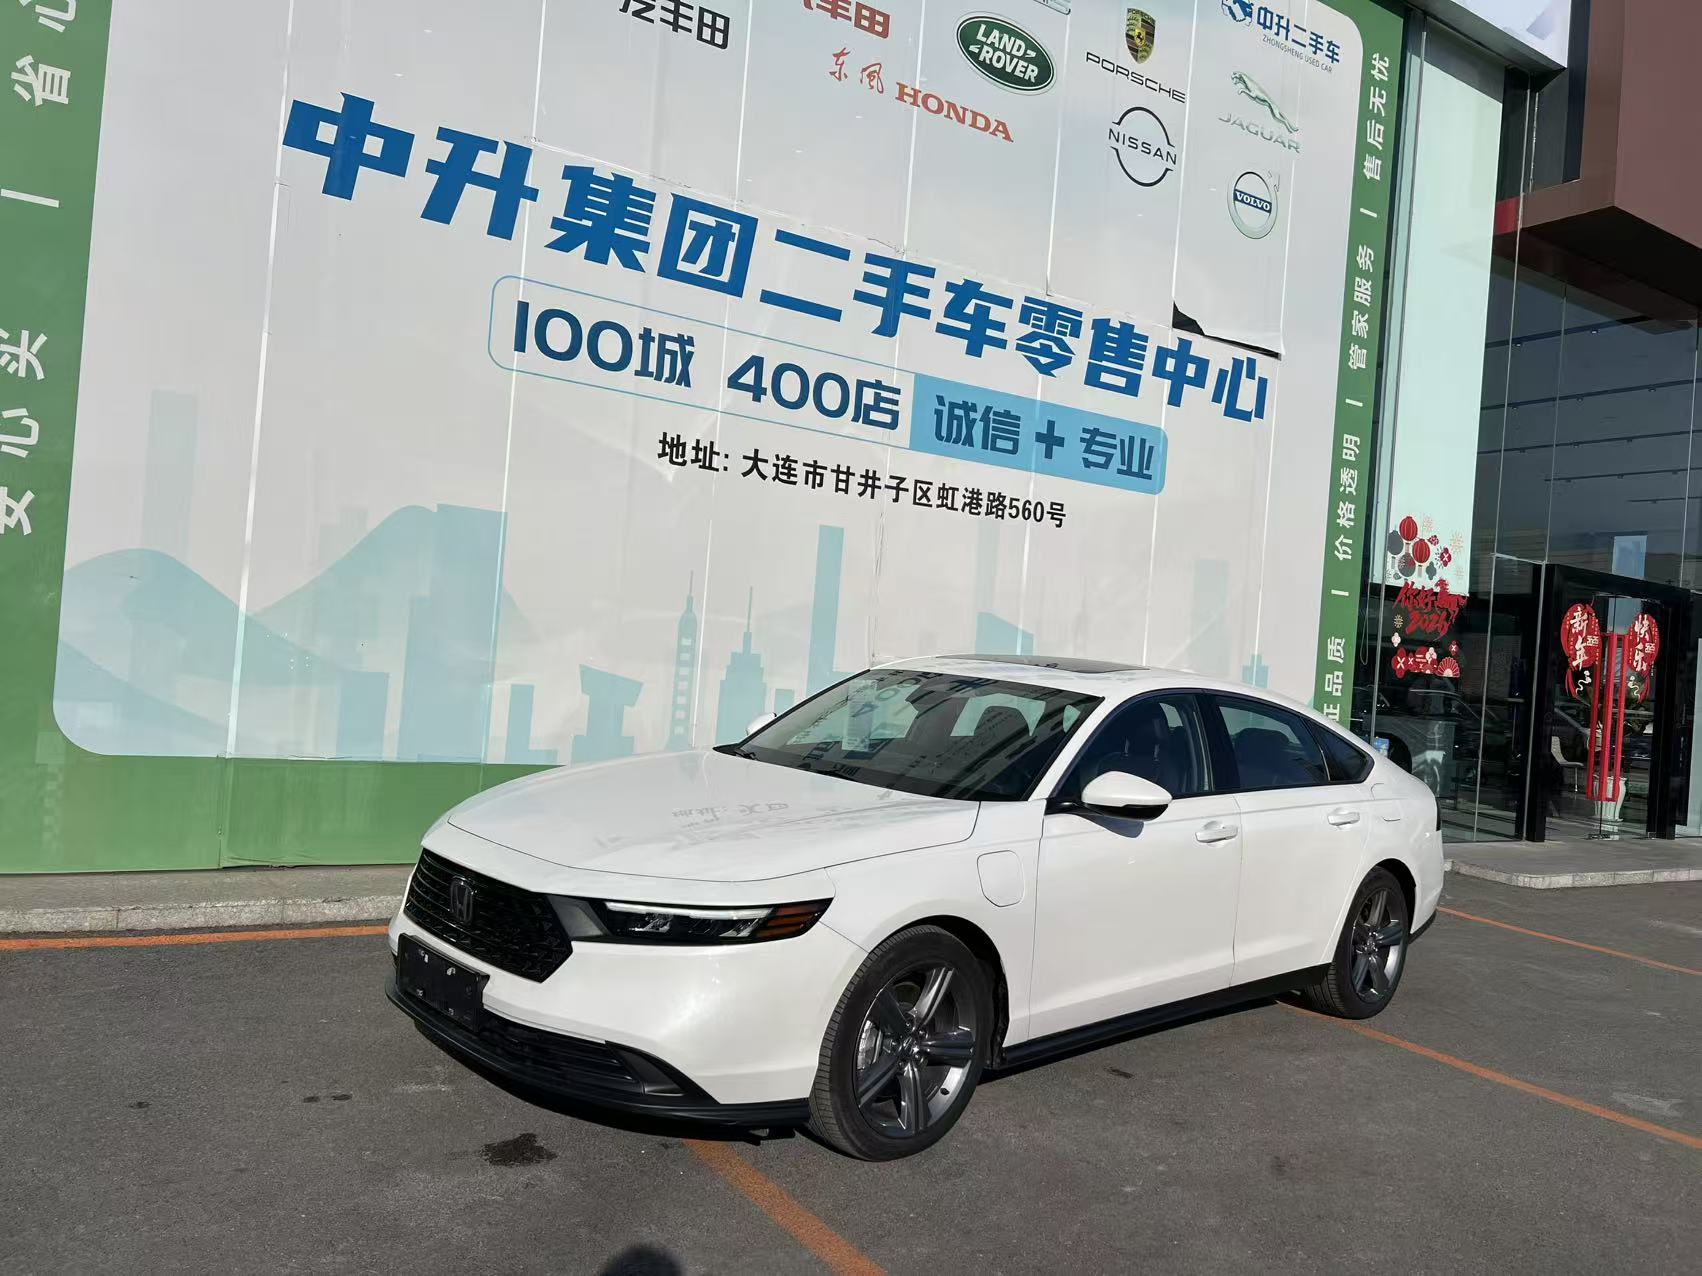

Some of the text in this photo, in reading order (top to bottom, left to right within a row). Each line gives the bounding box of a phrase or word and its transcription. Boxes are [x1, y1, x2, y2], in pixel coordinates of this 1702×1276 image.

[803, 0, 890, 39] 丰田
[976, 24, 1026, 57] LAND
[1256, 6, 1340, 64] 中升二手车
[979, 45, 1039, 83] ROVER
[1085, 51, 1187, 104] PORSCHE
[1262, 34, 1333, 73] ZHONGSHENG USED CAR
[895, 82, 1014, 143] HONDA
[1218, 113, 1300, 154] JAGUAR
[1108, 127, 1177, 166] NISSAN
[1235, 190, 1272, 212] VOLVO
[282, 92, 1268, 422] 中升集团二手车零售中心
[1334, 433, 1361, 561] 价格透明
[1348, 244, 1375, 371] 管家服务
[1363, 52, 1390, 182] 售后无忧
[513, 299, 902, 431] 100城 400店
[934, 394, 1021, 455] 诚信
[1079, 427, 1154, 480] 专业
[1570, 605, 1588, 671] 新年
[1634, 614, 1650, 672] 快乐
